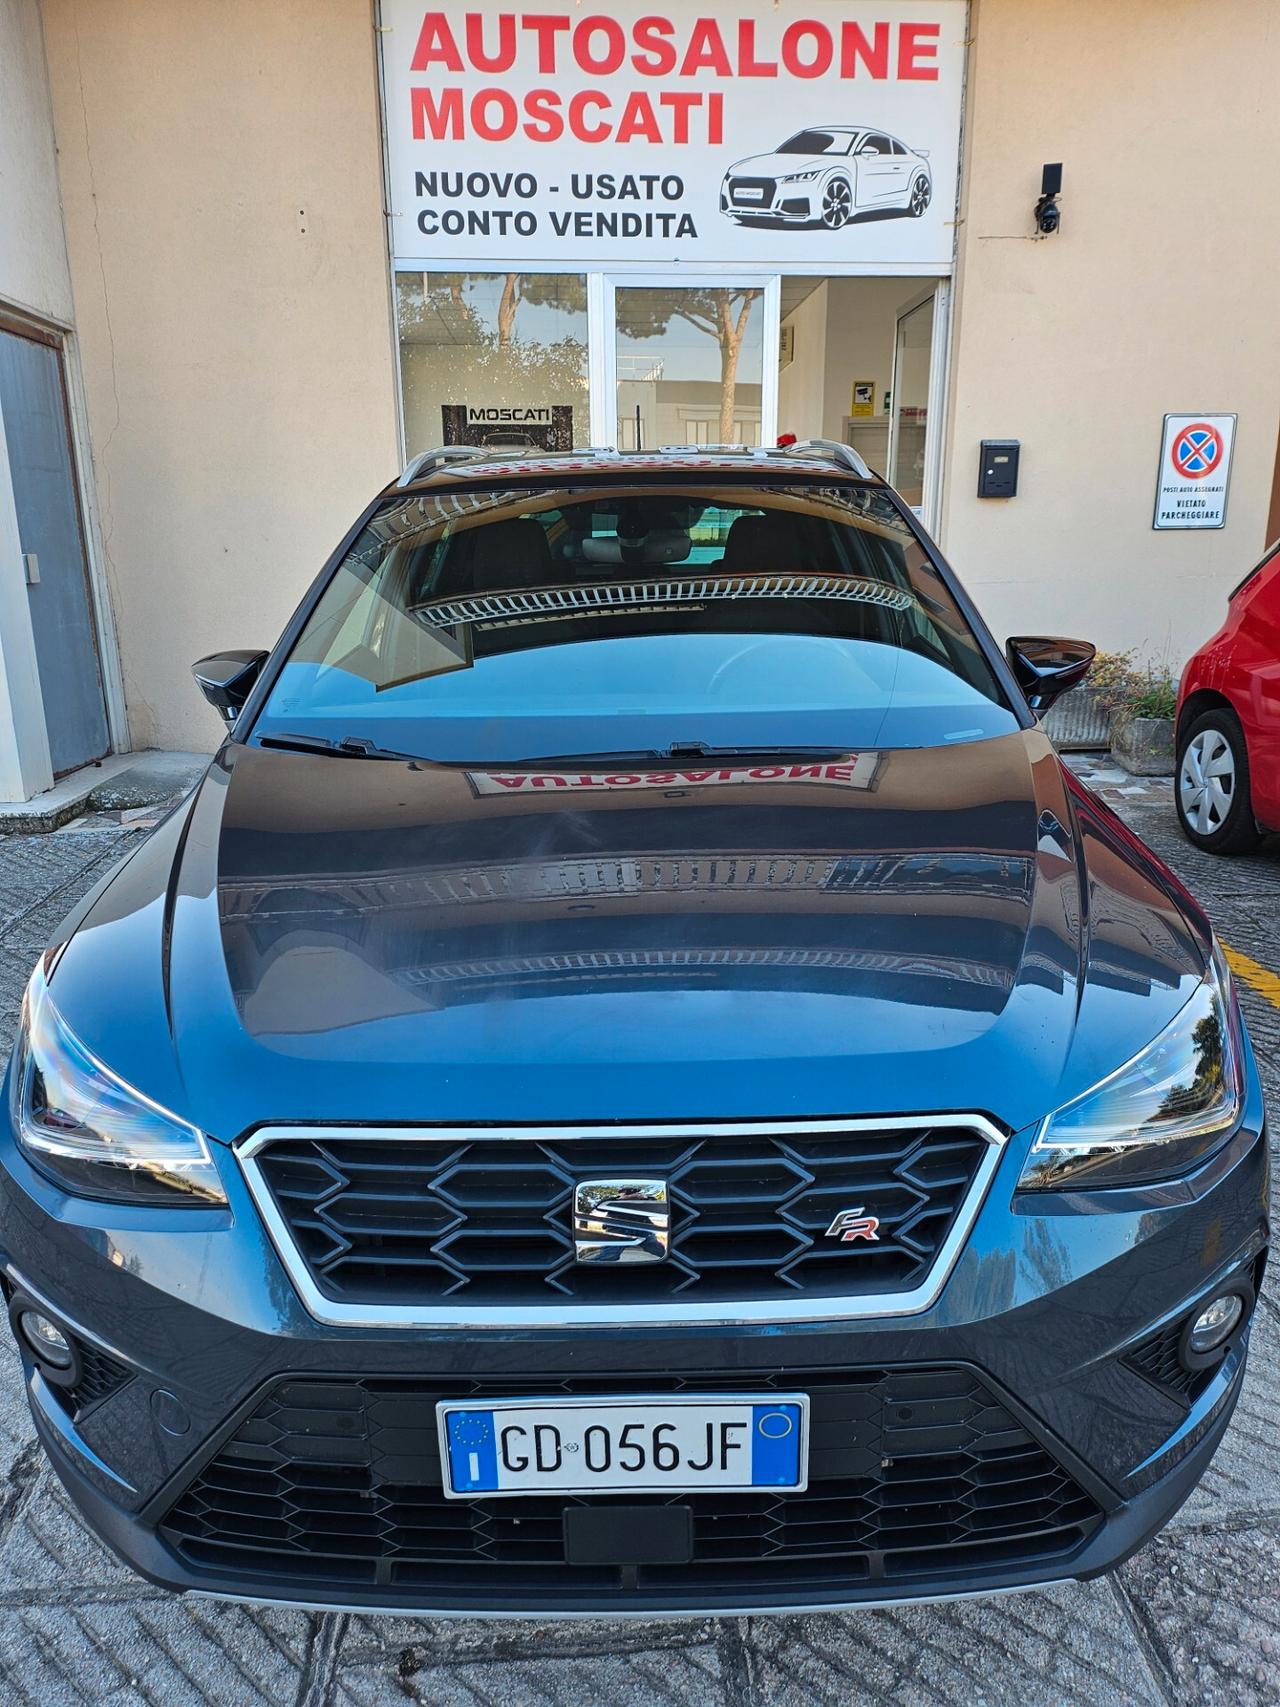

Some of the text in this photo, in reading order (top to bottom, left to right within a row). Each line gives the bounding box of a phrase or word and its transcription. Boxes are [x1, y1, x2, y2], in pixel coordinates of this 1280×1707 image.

[410, 11, 941, 81] AUTOSALONE
[410, 87, 724, 145] MOSCATI
[414, 171, 538, 199] NUOVO
[570, 174, 685, 201] USATO
[416, 209, 698, 239] CONTO VENDITA
[469, 408, 550, 421] MOSCATI
[1161, 510, 1220, 520] PARCHEGGIARE
[1177, 499, 1206, 508] VIETATO
[825, 1206, 880, 1242] FR
